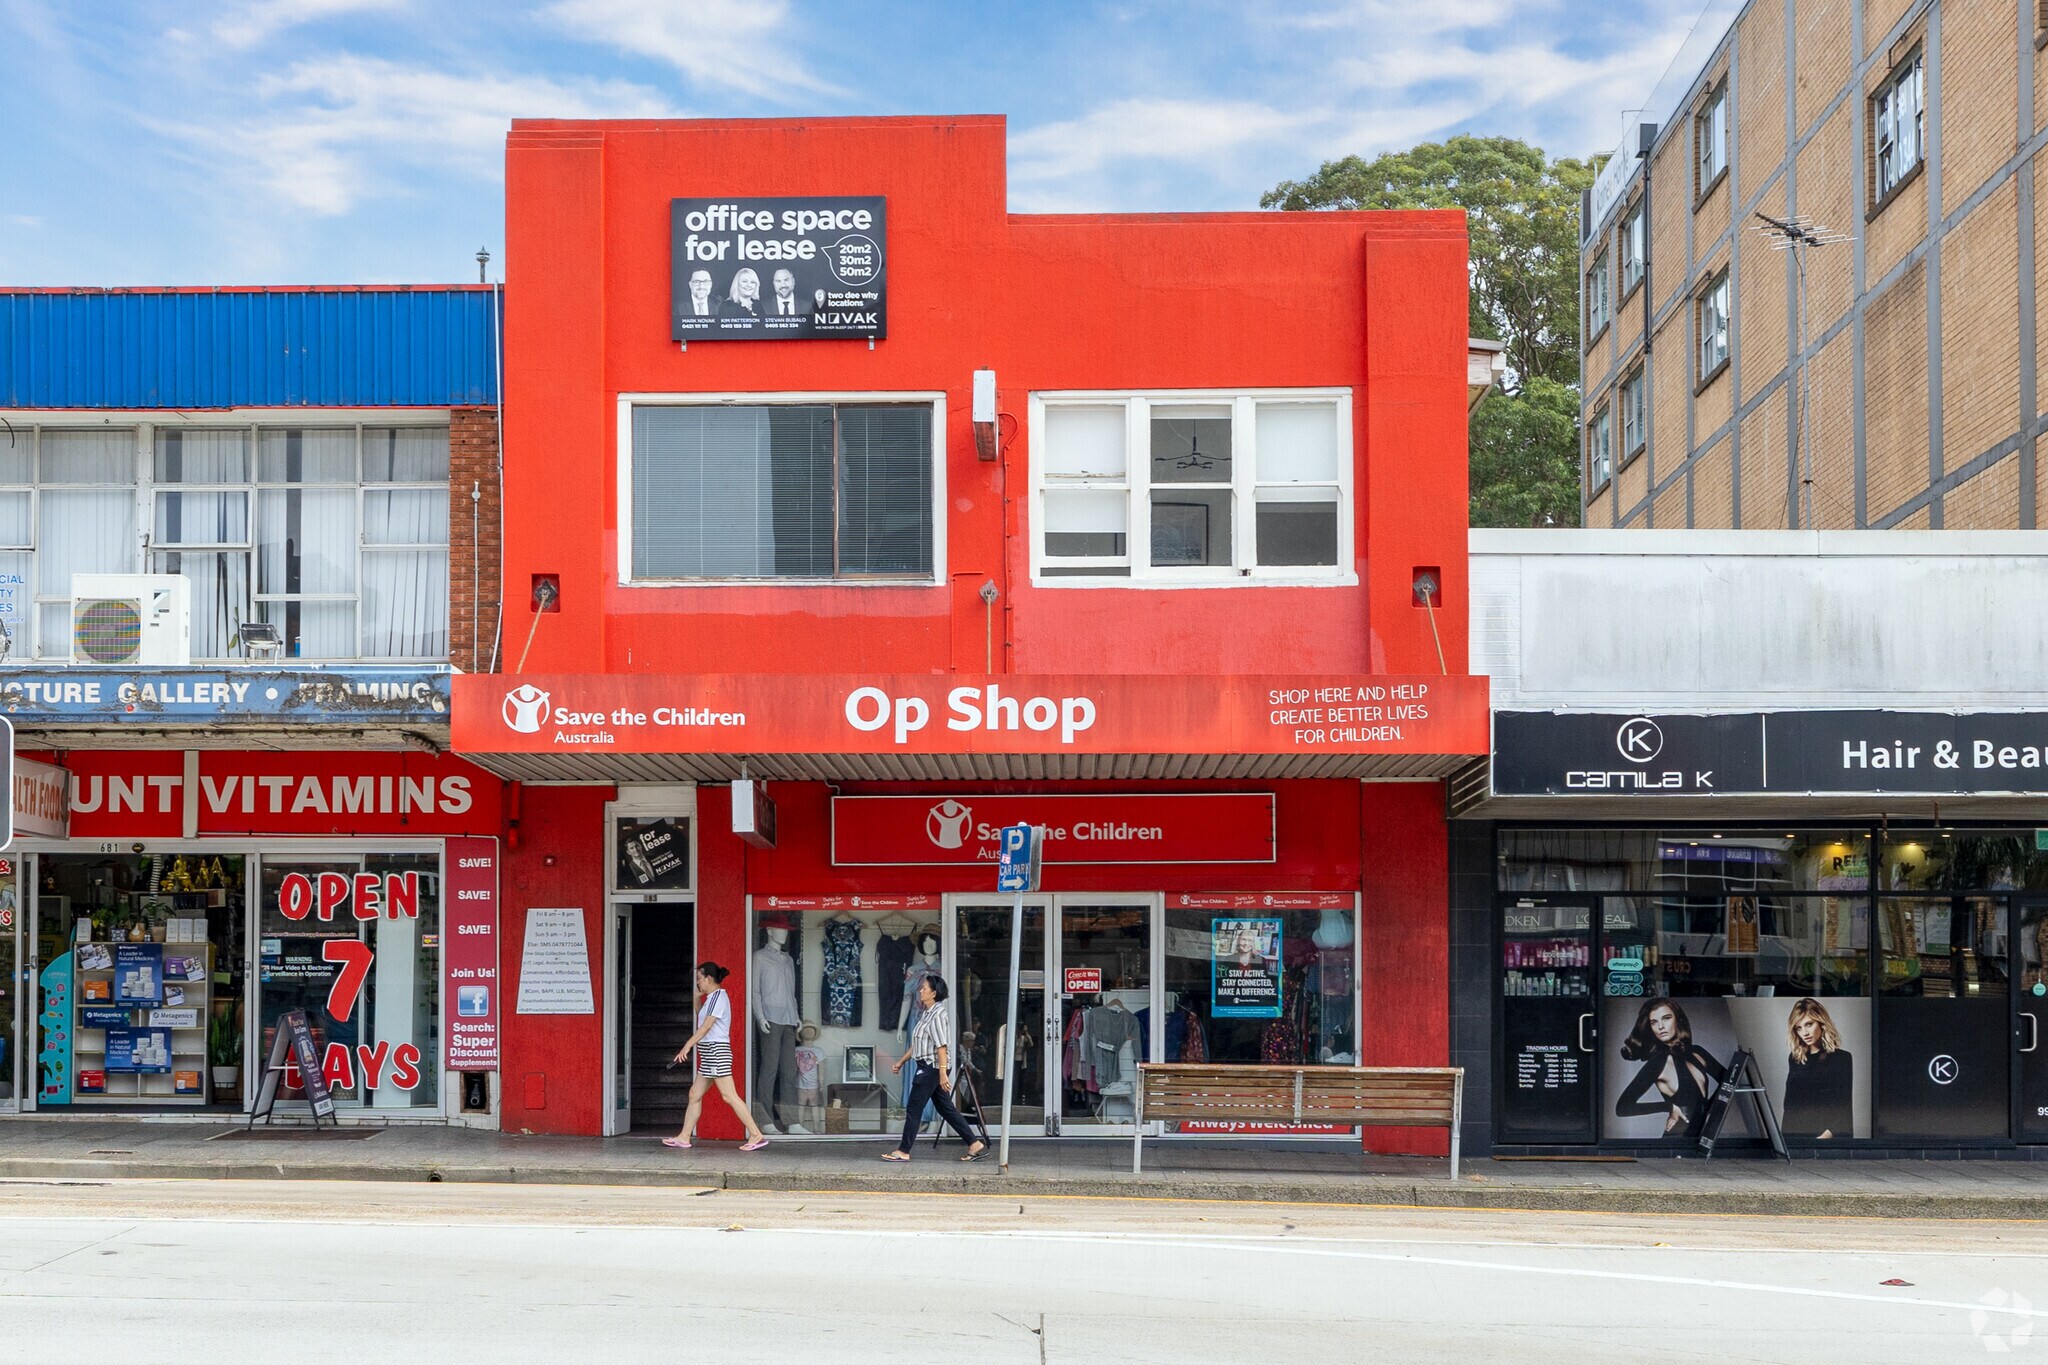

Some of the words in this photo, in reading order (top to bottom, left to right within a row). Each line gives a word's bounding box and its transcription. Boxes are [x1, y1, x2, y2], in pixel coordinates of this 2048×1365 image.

[685, 205, 774, 231] office
[782, 209, 872, 235] space
[685, 235, 730, 261] for
[738, 234, 816, 260] lease
[840, 244, 872, 254] 20m2
[840, 256, 872, 265] 30m2
[840, 267, 872, 276] 50m2
[862, 292, 879, 300] why
[815, 312, 878, 324] NOVAK
[0, 682, 100, 703] CTURE
[118, 682, 250, 703] GALLERY
[300, 682, 431, 703] FRAMING
[1269, 690, 1310, 704] SHOP
[1315, 688, 1352, 702] HERE
[1357, 686, 1386, 701] AND
[1391, 684, 1427, 699] HELP
[554, 708, 605, 726] Save
[611, 708, 647, 726] the
[653, 708, 746, 726] Children
[845, 686, 929, 744] Op
[946, 684, 1096, 744] Shop
[1270, 709, 1323, 725] CREATE
[1328, 707, 1382, 723] BETTER
[1387, 705, 1429, 720] LIVES
[554, 731, 614, 744] Australia
[1295, 729, 1325, 744] FOR
[1330, 726, 1404, 742] CHILDREN.
[1628, 729, 1652, 751] K
[1843, 740, 1920, 768] Hair
[1933, 740, 1960, 768] &
[1974, 740, 2048, 768] Bea
[1696, 771, 1713, 788] K
[200, 776, 473, 814] VITAMINS
[639, 830, 656, 842] for
[977, 822, 1002, 840] Sa
[1042, 822, 1066, 840] he
[1072, 822, 1163, 840] Children
[100, 844, 118, 852] 681
[642, 833, 672, 852] lease
[1008, 829, 1024, 858] P
[459, 858, 492, 868] SAVE!
[1000, 864, 1012, 876] CAR
[278, 870, 419, 922] OPEN
[458, 890, 491, 900] SAVE!
[458, 925, 491, 934] SAVE!
[451, 968, 474, 978] Join
[478, 968, 495, 978] Us!
[1244, 970, 1266, 978] ACTIVE,
[322, 940, 374, 1023] 7
[1068, 981, 1099, 989] OPEN
[1237, 979, 1273, 987] CONNECTED,
[453, 1023, 495, 1032] Search:
[453, 1035, 495, 1050] Super
[450, 1048, 498, 1057] Discount
[450, 1059, 498, 1067] Supplements
[1936, 1062, 1951, 1077] K
